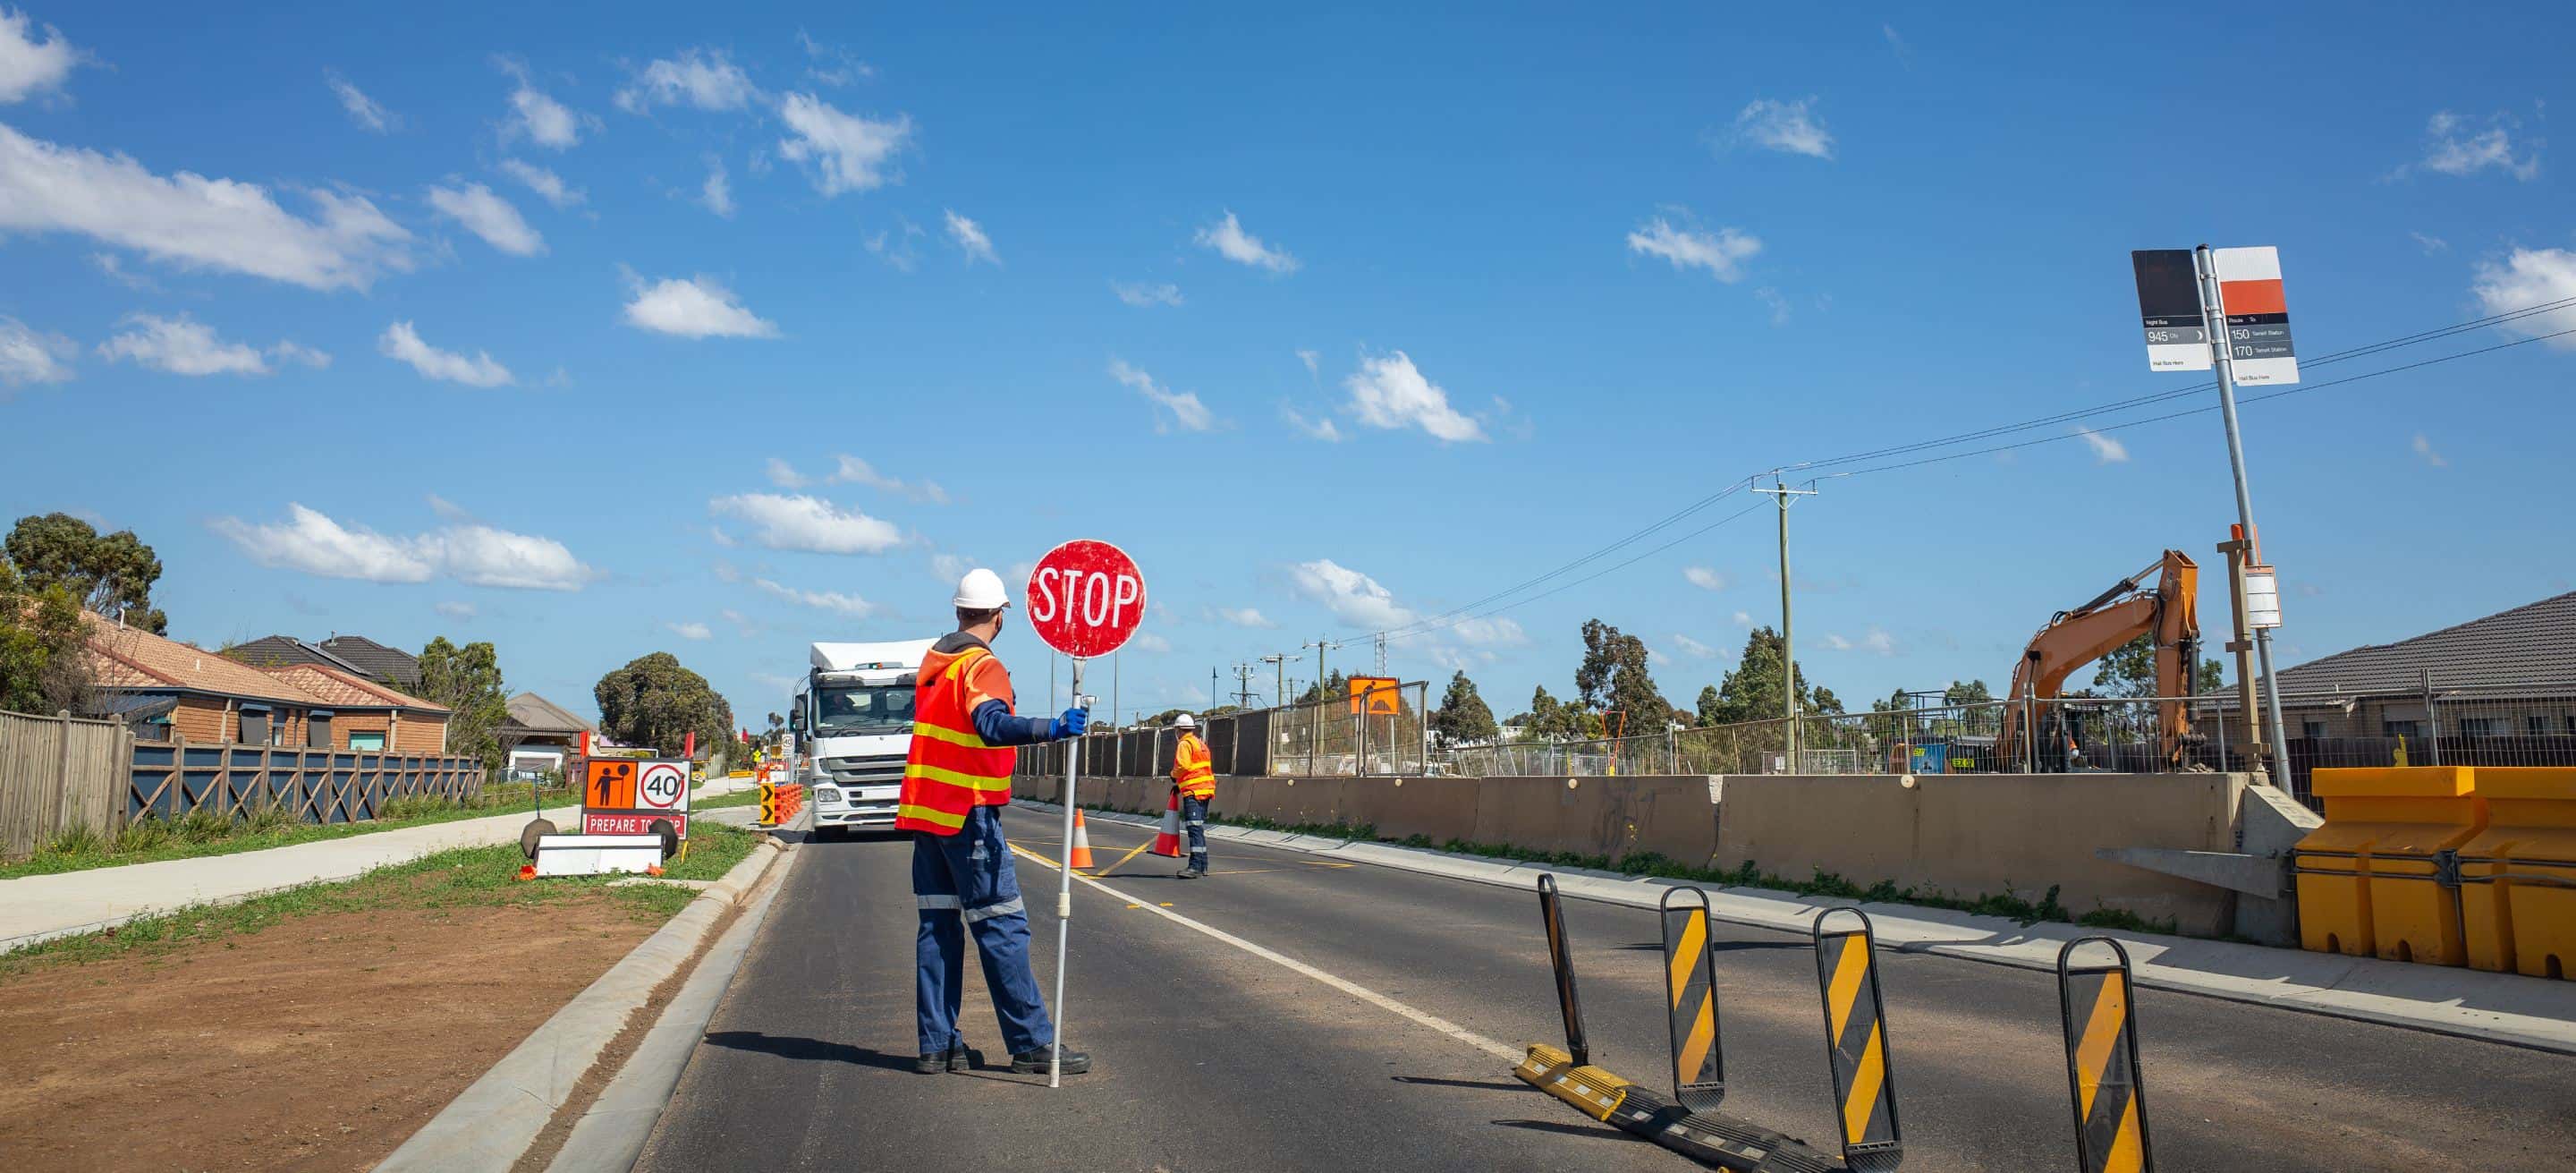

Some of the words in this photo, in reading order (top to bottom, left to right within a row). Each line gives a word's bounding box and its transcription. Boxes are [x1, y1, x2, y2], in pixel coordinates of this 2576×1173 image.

[2148, 331, 2168, 342] 945
[2232, 328, 2250, 340] 150
[2234, 345, 2252, 356] 170
[1033, 566, 1138, 628] STOP
[647, 776, 678, 795] 40
[590, 818, 635, 832] PREPARE
